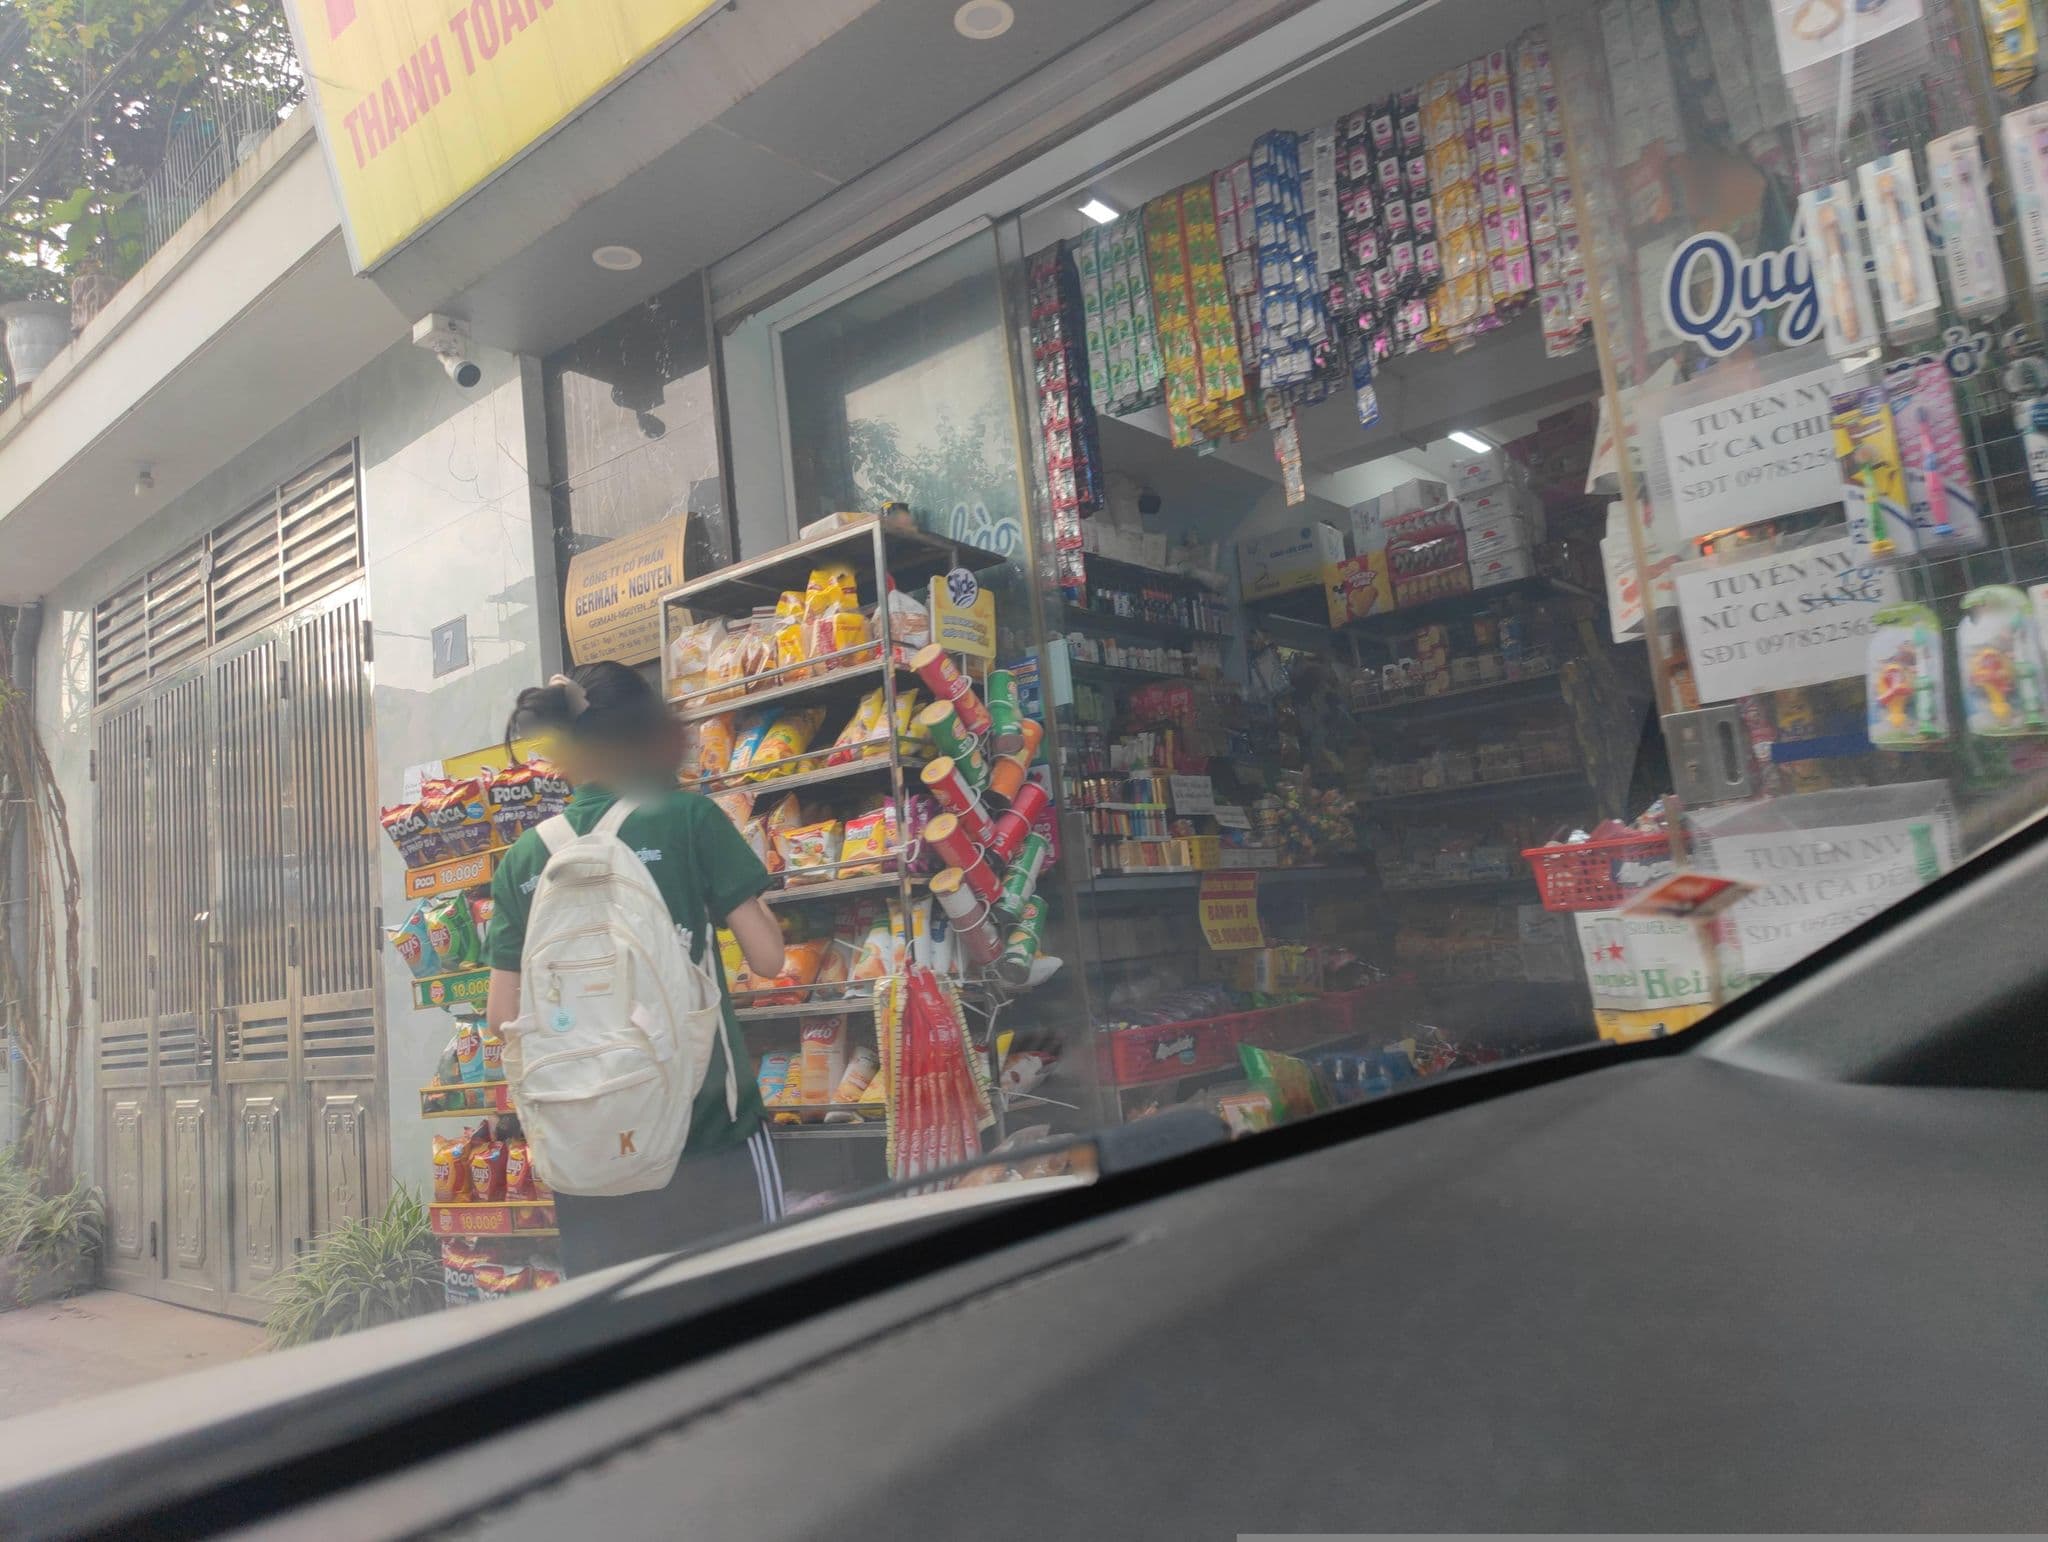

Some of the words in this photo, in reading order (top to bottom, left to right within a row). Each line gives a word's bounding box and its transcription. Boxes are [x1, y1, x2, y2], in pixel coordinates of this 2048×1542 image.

[342, 34, 453, 169] THANH
[1724, 434, 1765, 459] CA
[575, 583, 618, 617] GERMAN
[1751, 600, 1792, 623] CA
[443, 630, 455, 662] 7
[491, 785, 532, 804] POCA
[534, 777, 571, 796] POCA
[387, 813, 426, 841] POCA
[430, 805, 466, 827] POCA
[414, 874, 435, 889] POCA
[619, 1130, 637, 1156] K
[444, 1267, 475, 1288] POCA
